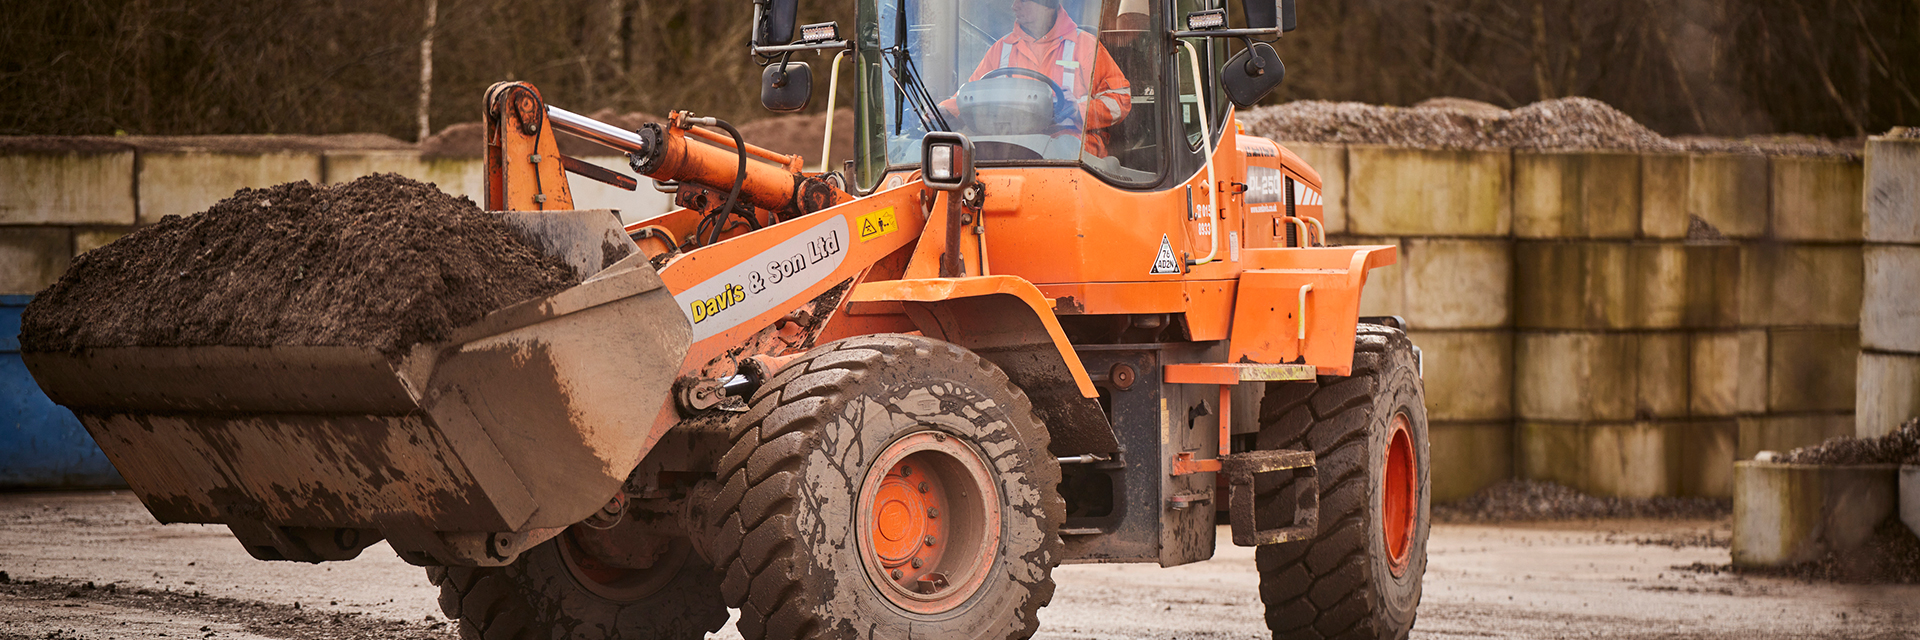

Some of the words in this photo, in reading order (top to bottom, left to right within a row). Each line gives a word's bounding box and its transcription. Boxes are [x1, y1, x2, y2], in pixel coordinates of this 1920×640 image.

[690, 283, 746, 324] Davis
[747, 270, 765, 294] &
[766, 253, 806, 284] Son
[807, 230, 840, 265] Ltd
